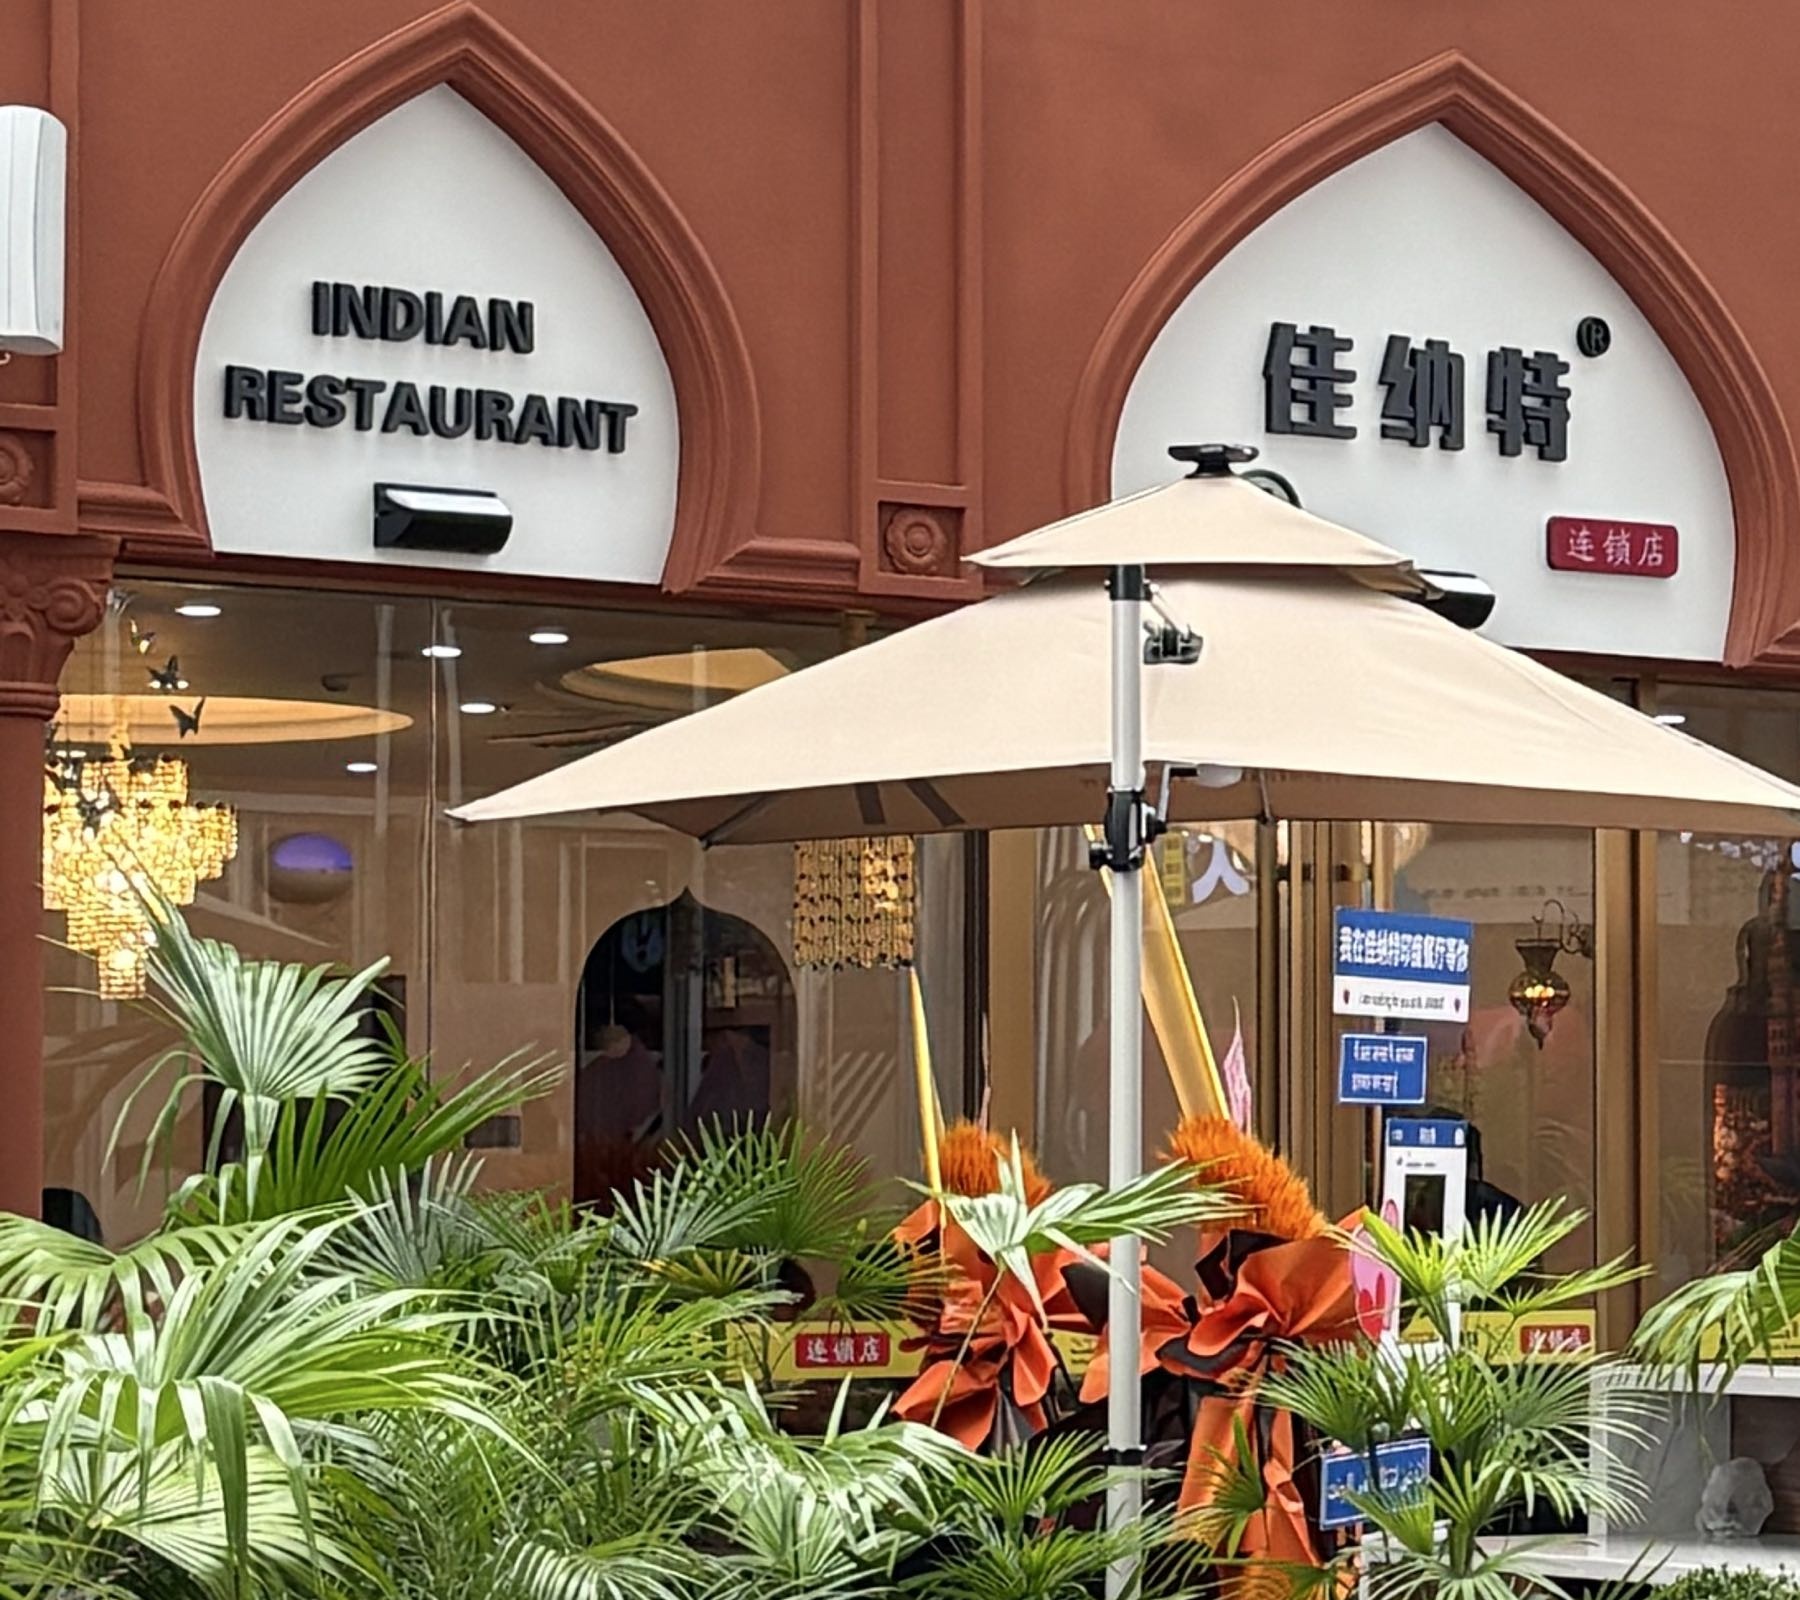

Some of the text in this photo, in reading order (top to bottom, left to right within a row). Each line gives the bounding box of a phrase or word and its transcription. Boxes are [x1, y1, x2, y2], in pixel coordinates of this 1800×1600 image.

[311, 281, 535, 354] INDIAN
[223, 364, 638, 454] RESTAURANT
[1262, 322, 1571, 462] 佳纳特
[1566, 527, 1665, 568] 连锁店
